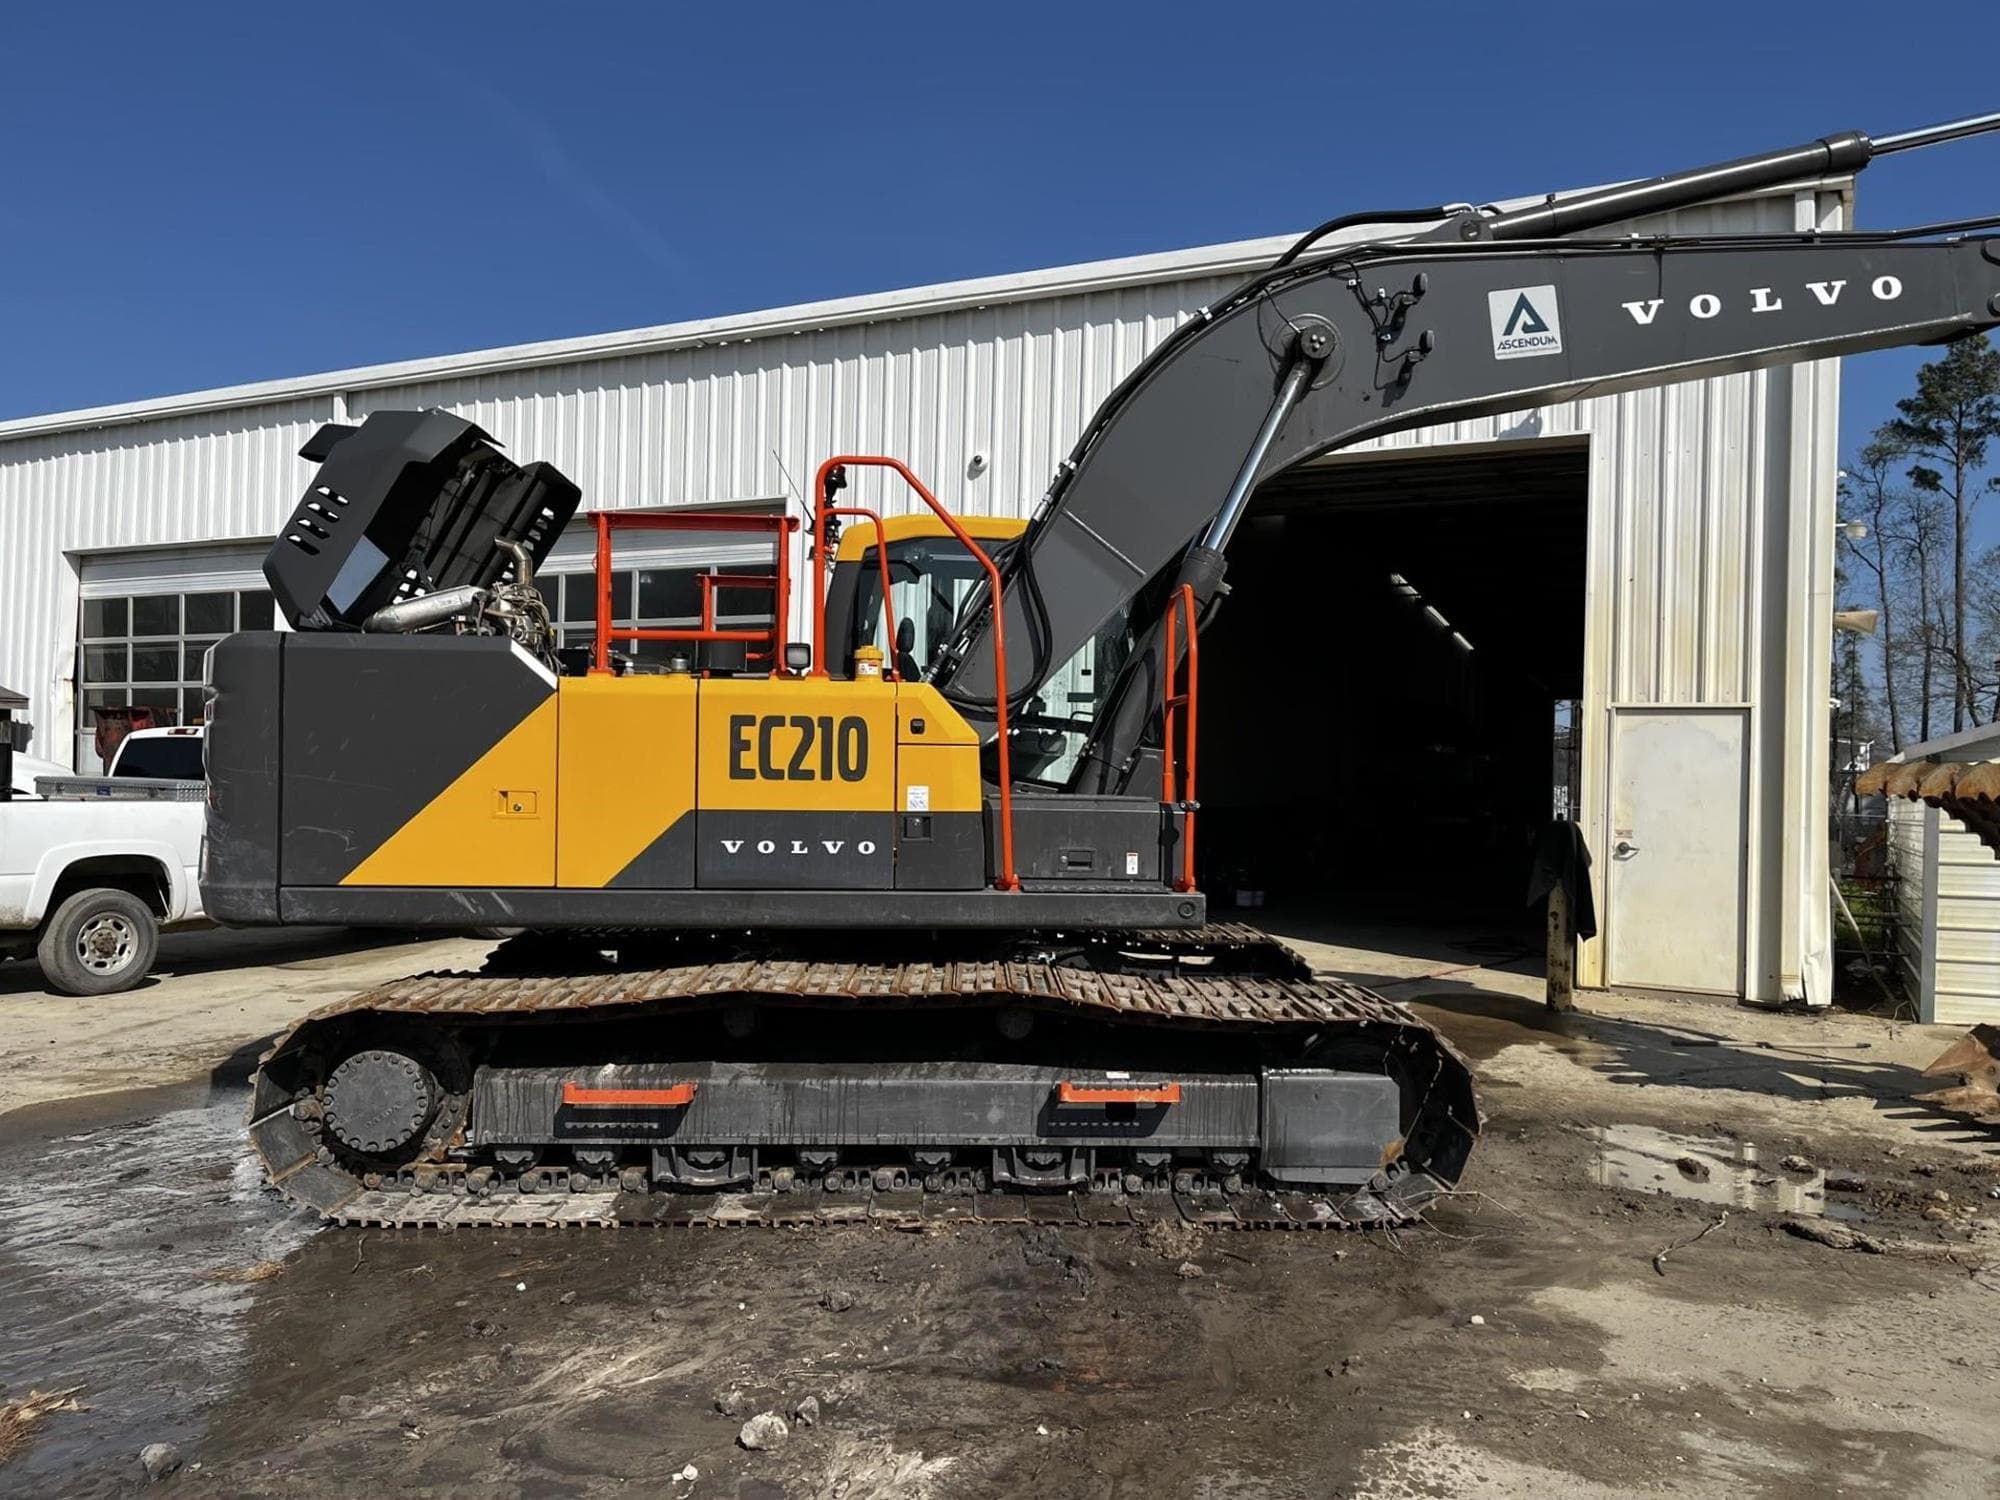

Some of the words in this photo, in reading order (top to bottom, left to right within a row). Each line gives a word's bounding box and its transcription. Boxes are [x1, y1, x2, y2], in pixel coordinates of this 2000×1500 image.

[1621, 275, 1903, 325] VOLVO
[1497, 335, 1558, 351] ASCENDUM
[728, 714, 869, 782] EC210
[720, 840, 876, 854] VOLVO
